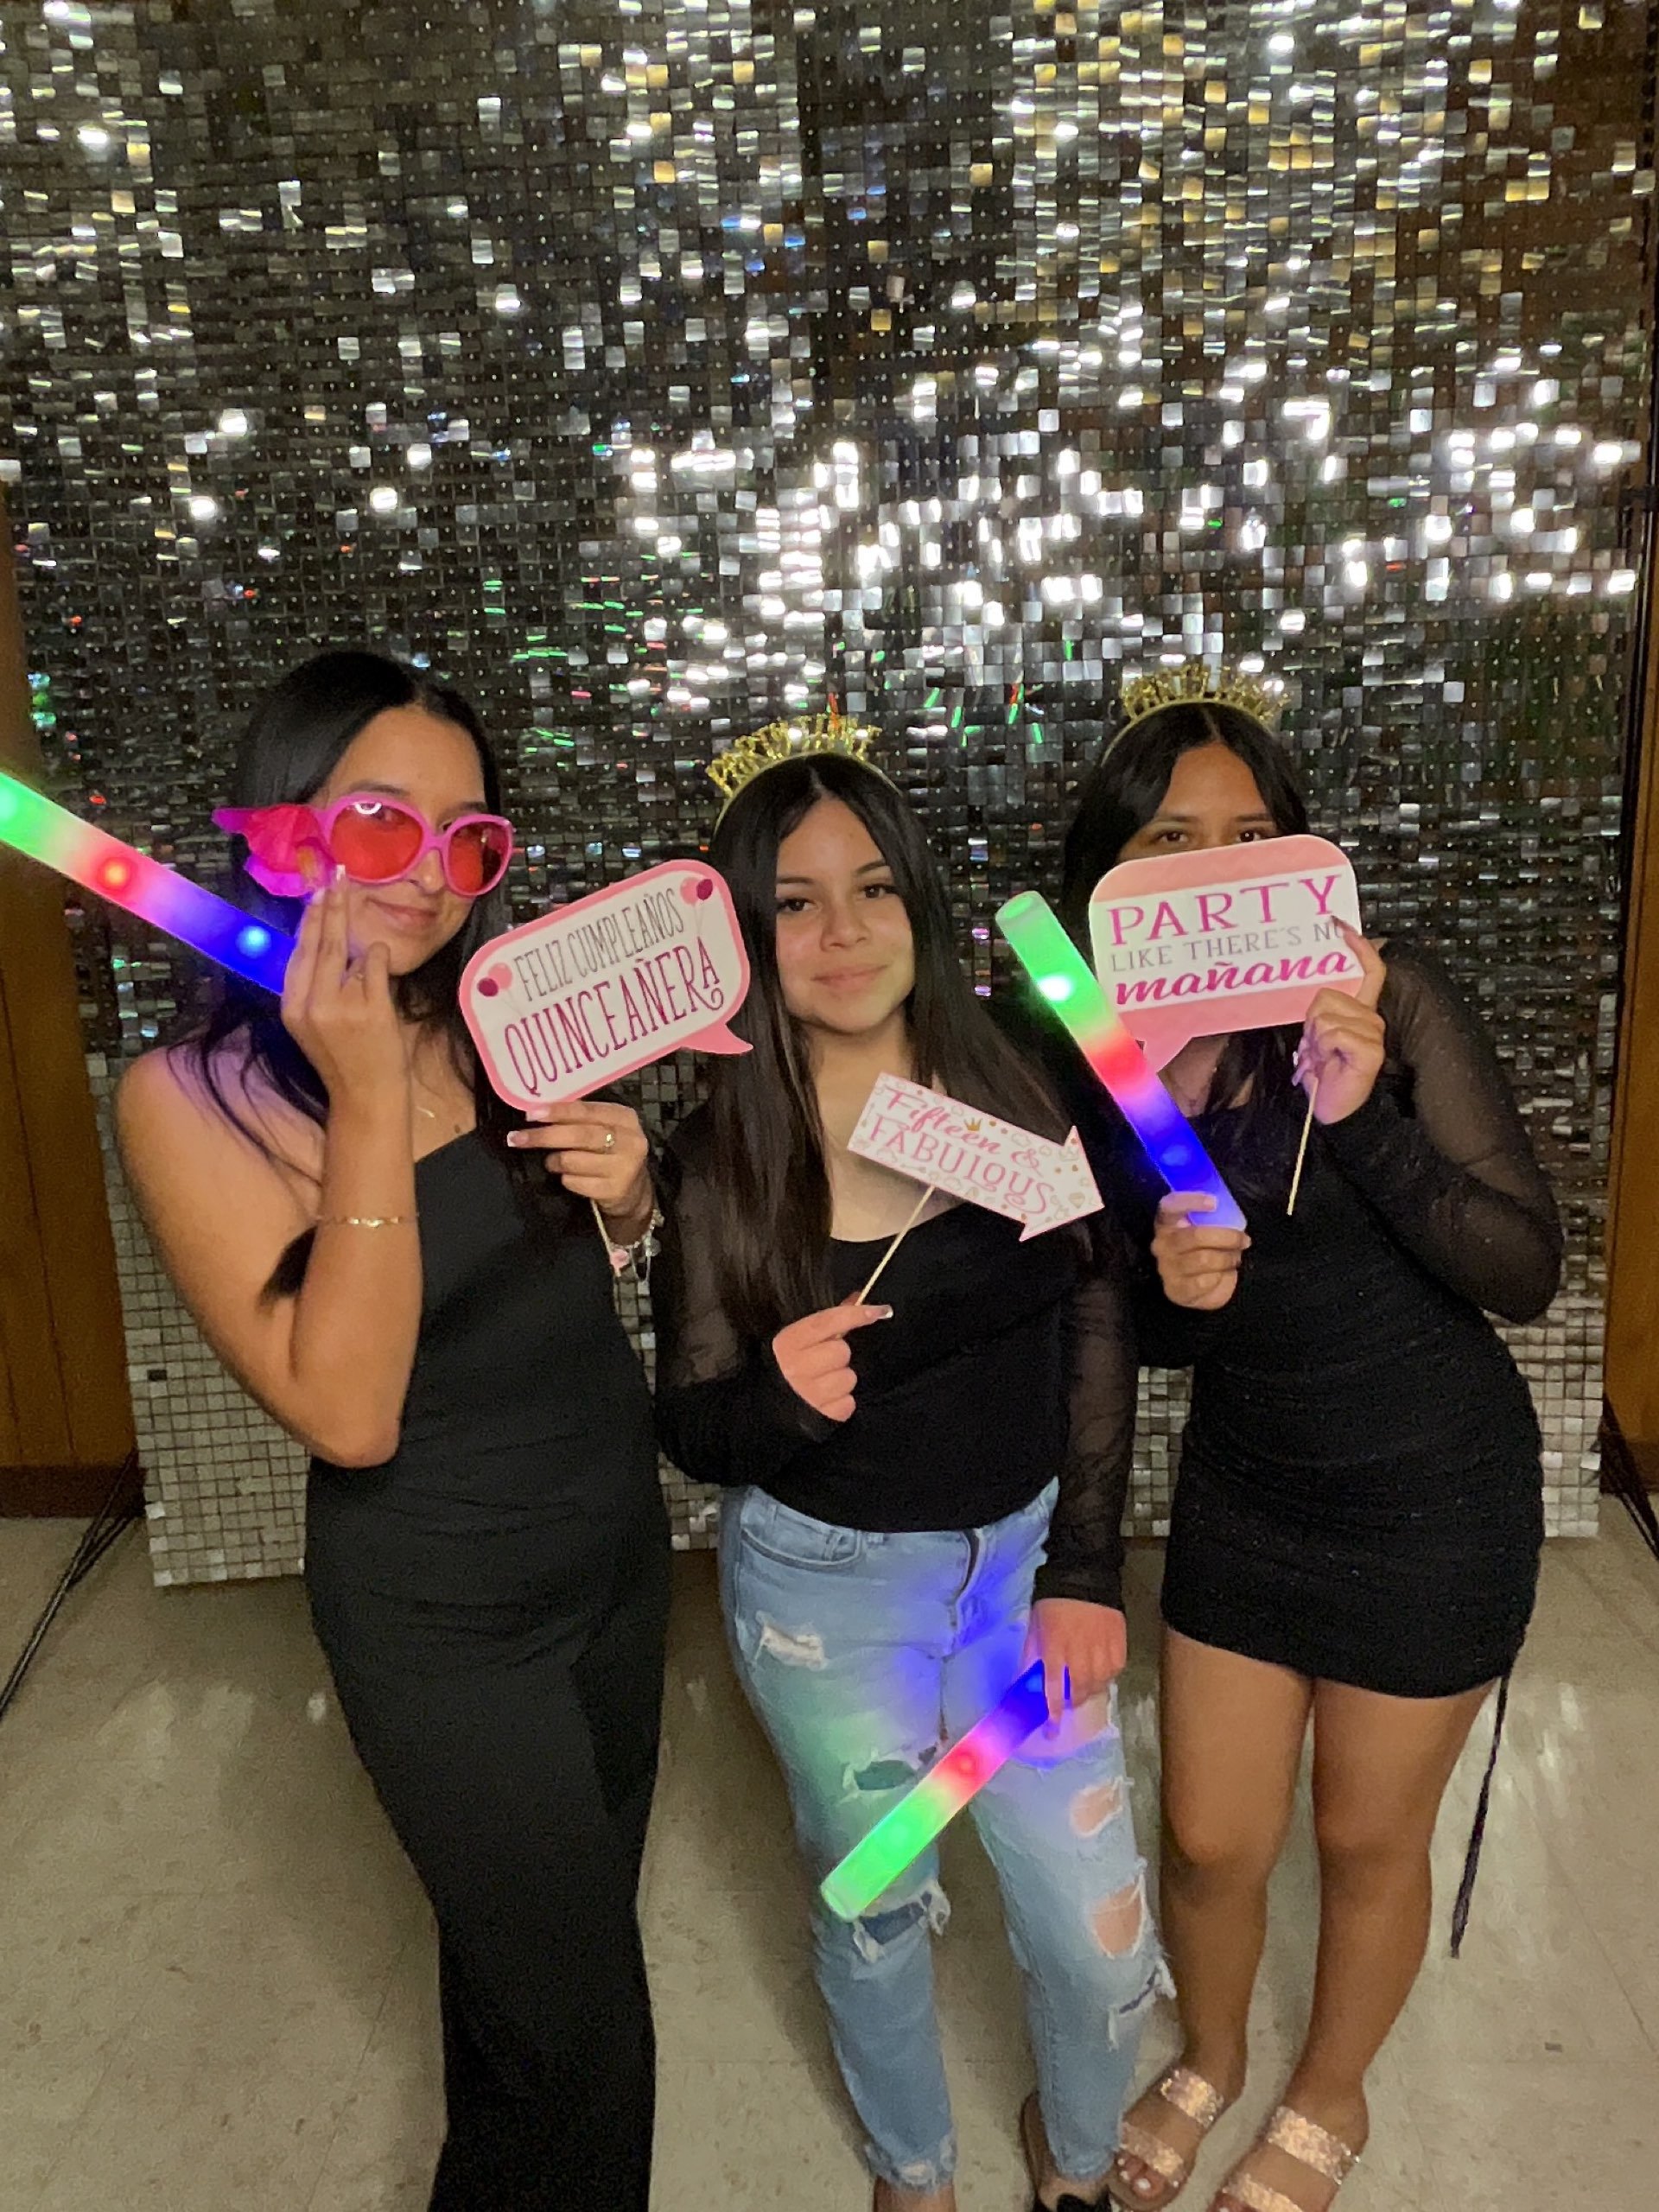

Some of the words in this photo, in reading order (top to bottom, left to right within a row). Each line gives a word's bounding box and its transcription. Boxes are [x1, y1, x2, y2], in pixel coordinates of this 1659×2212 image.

[514, 940, 574, 1001] FELIZ
[566, 887, 684, 977] CUMPLEAÑOS
[1107, 874, 1342, 946] PARTY
[1112, 945, 1172, 972] LIKE
[1184, 926, 1301, 960] THERE'S
[504, 937, 724, 1096] QUINCEAÑERA
[1116, 951, 1355, 1005] mañana
[868, 1114, 1054, 1216] FABULOUS
[886, 1086, 1001, 1154] Fifteen
[1010, 1148, 1044, 1178] &
